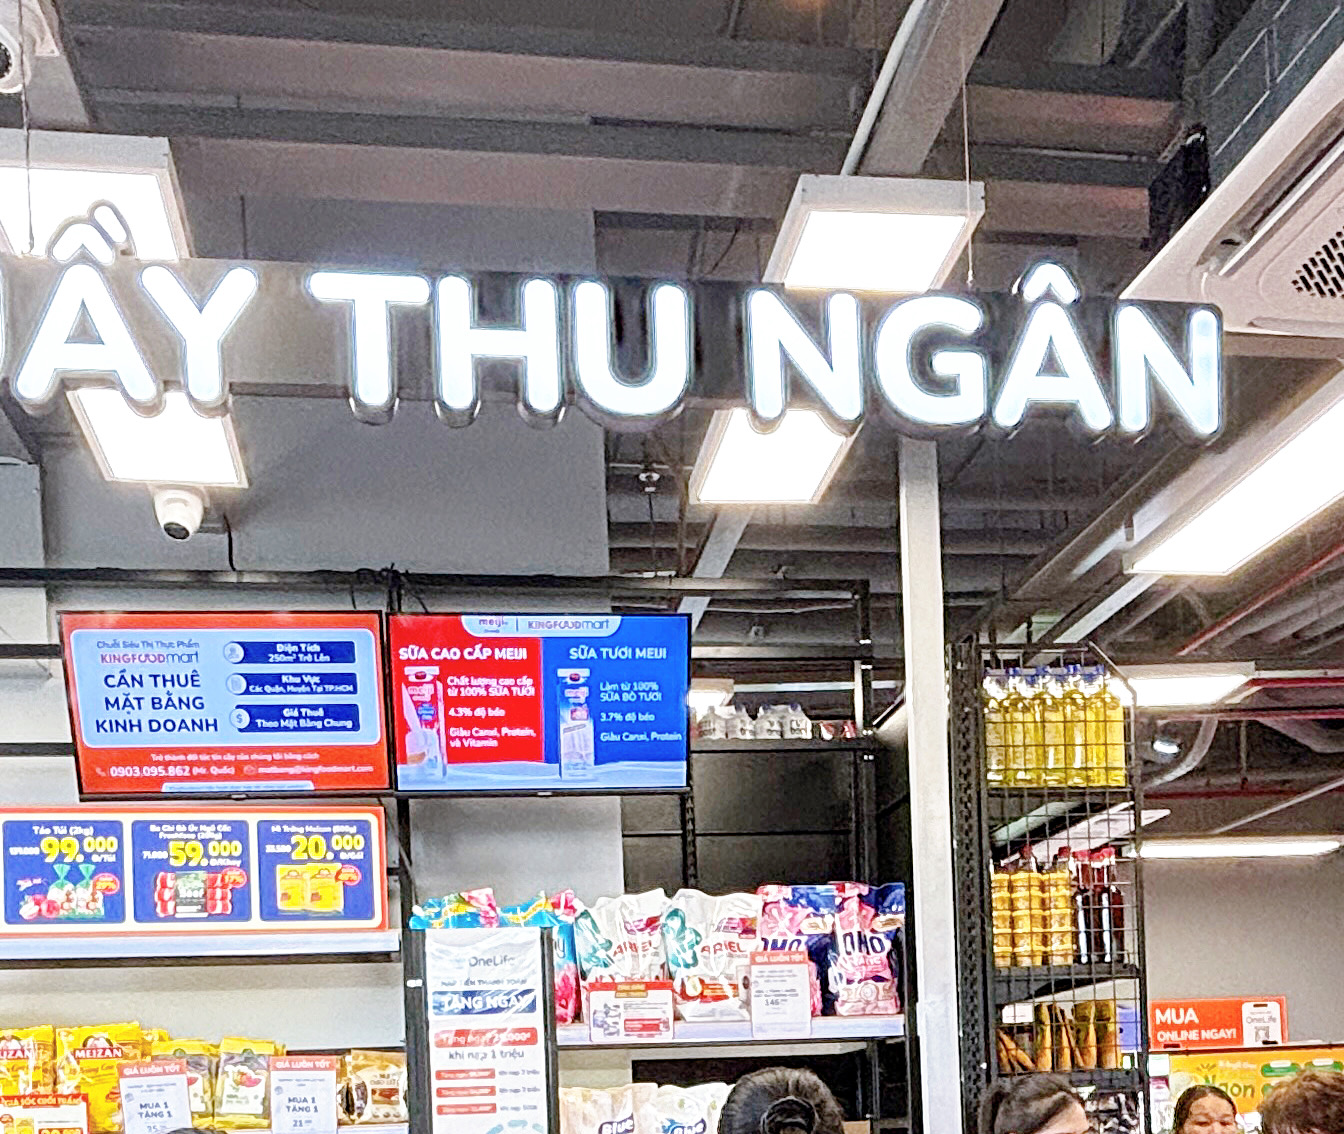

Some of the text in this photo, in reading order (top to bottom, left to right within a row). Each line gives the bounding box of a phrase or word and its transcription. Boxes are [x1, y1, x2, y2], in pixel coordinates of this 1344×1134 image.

[308, 272, 689, 412] THU
[746, 262, 1224, 432] NGÂN
[100, 651, 199, 664] KINGFOODmart
[398, 644, 428, 660] SỮA
[430, 647, 461, 660] CAO
[463, 642, 492, 660] CẤP
[569, 644, 598, 660] SỮA
[600, 645, 632, 659] TƯƠI
[148, 669, 201, 688] THUÊ
[104, 690, 205, 715] MẶT BẰNG
[96, 718, 218, 733] KINH DOANH
[40, 836, 118, 863] 99.000
[169, 840, 242, 867] 59.000
[291, 834, 365, 860] 20.000
[468, 955, 516, 968] OneLife
[1155, 1007, 1199, 1025] MUA
[1157, 1027, 1237, 1043] ONLINE NGAY!
[74, 1048, 122, 1059] MEIZAN
